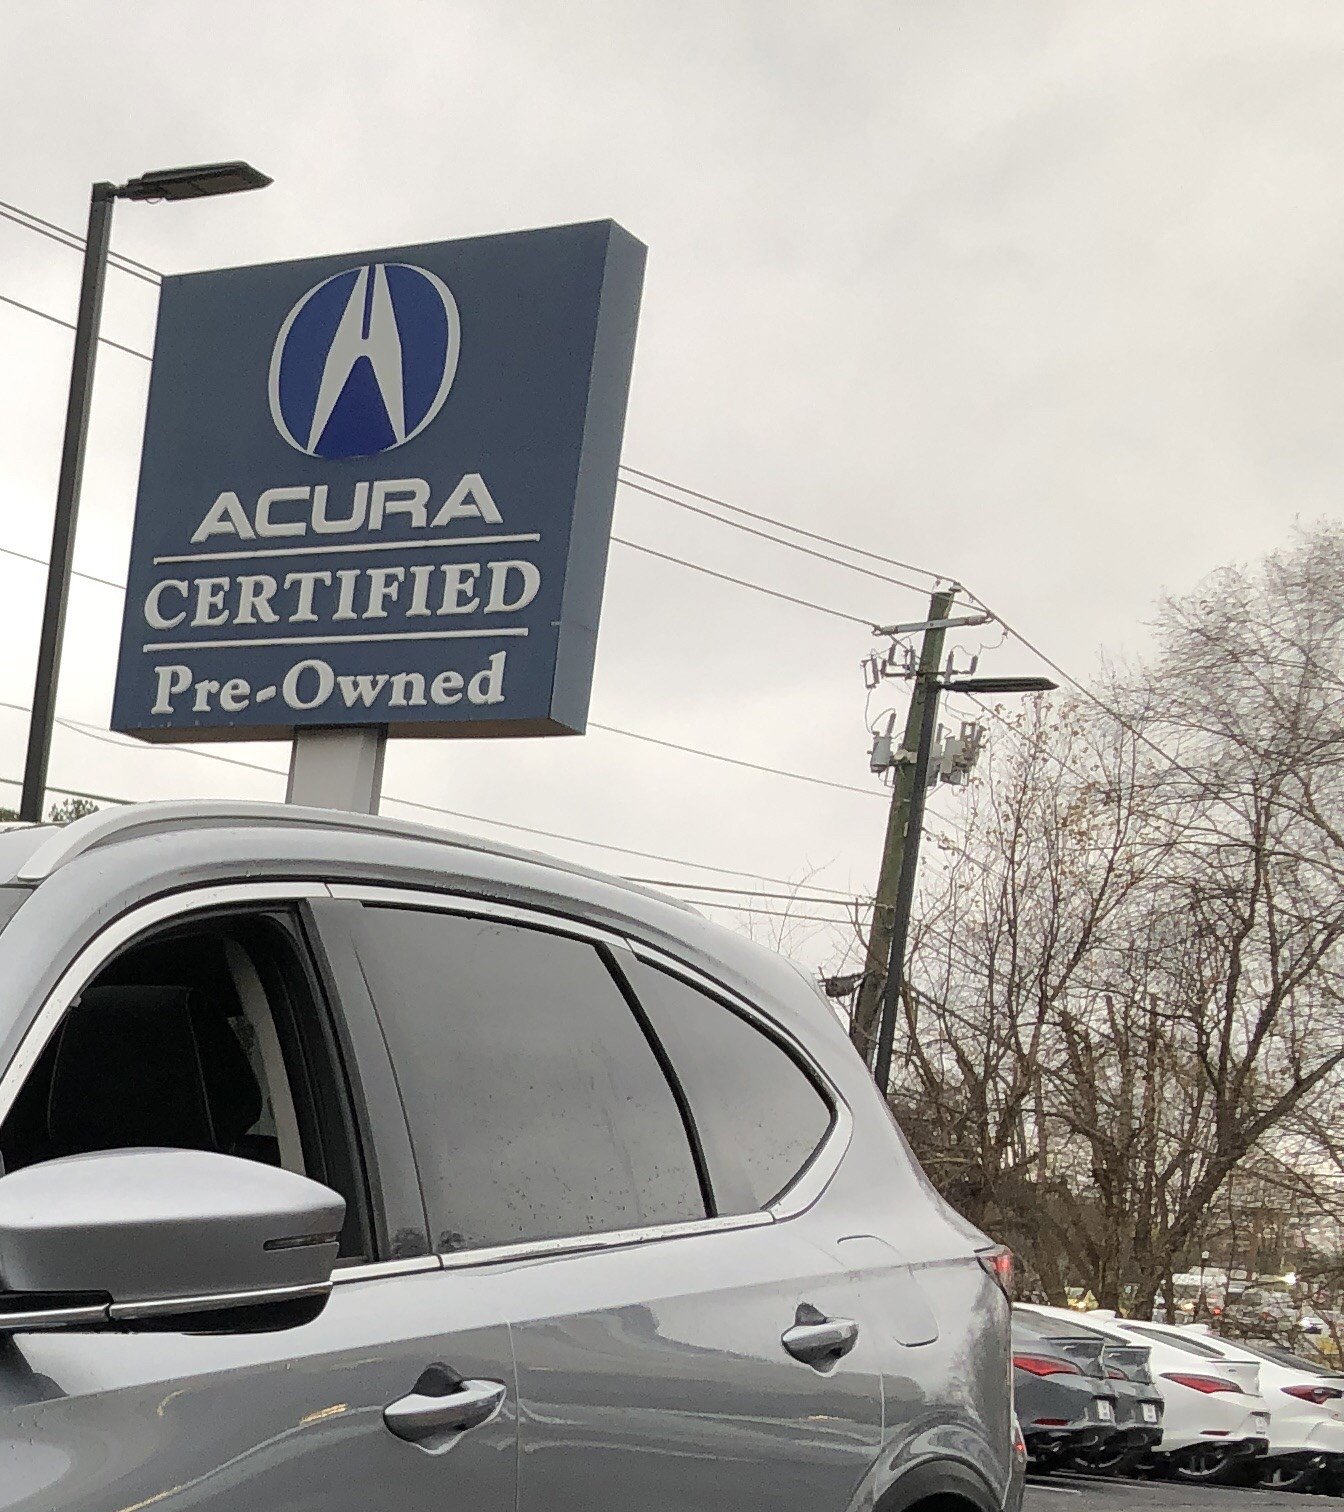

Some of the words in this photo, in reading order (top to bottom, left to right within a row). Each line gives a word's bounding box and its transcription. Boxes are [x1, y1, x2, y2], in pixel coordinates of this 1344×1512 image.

[190, 473, 503, 543] ACURA
[143, 560, 541, 631] CERTIFIED
[150, 651, 507, 716] Pre-Owned
